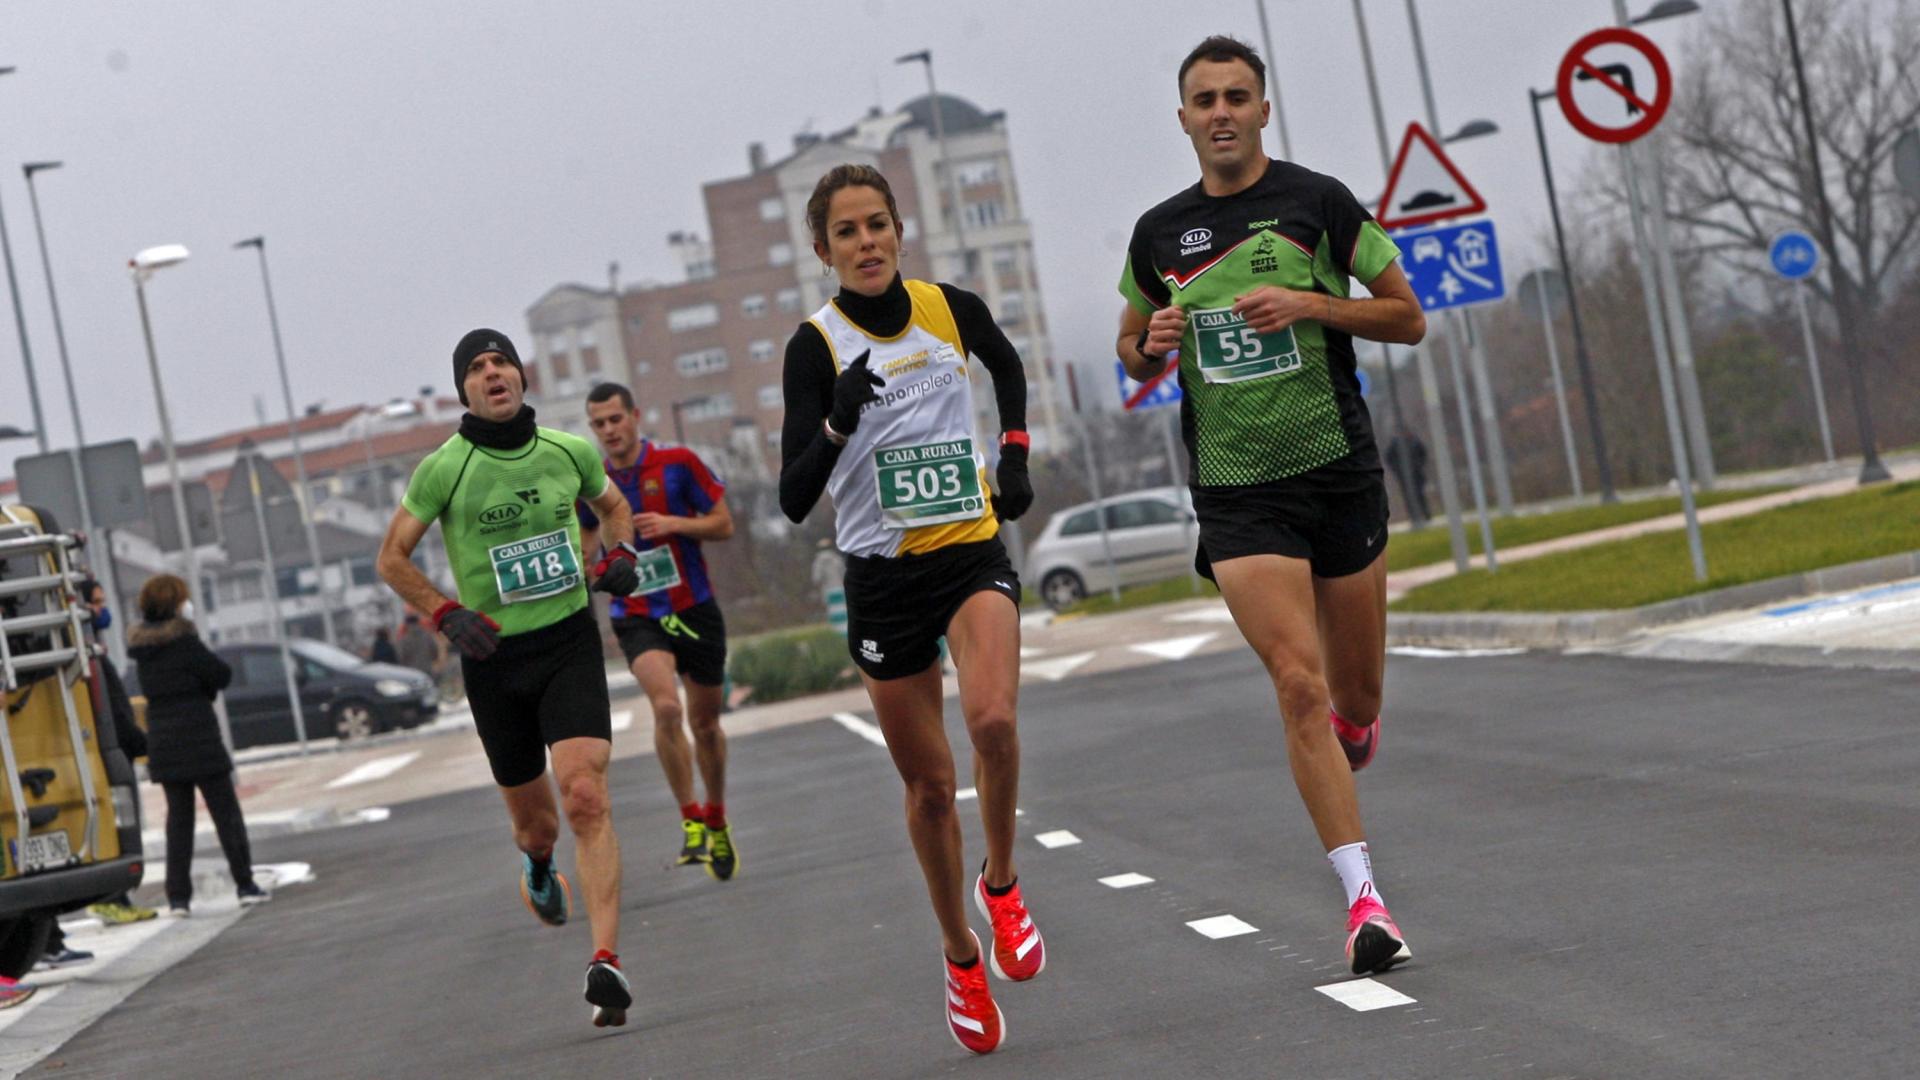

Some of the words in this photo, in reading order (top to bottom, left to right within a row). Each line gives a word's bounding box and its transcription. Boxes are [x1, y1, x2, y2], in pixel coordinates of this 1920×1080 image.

[1185, 231, 1207, 243] KIA
[1200, 313, 1229, 327] CAJA
[1218, 327, 1263, 363] 55
[883, 451, 917, 465] CAJA
[920, 442, 966, 458] RURAL
[894, 463, 962, 504] 503
[486, 506, 517, 522] KIA
[499, 544, 527, 559] CAJA
[527, 534, 562, 552] RURAL
[509, 551, 565, 587] 118
